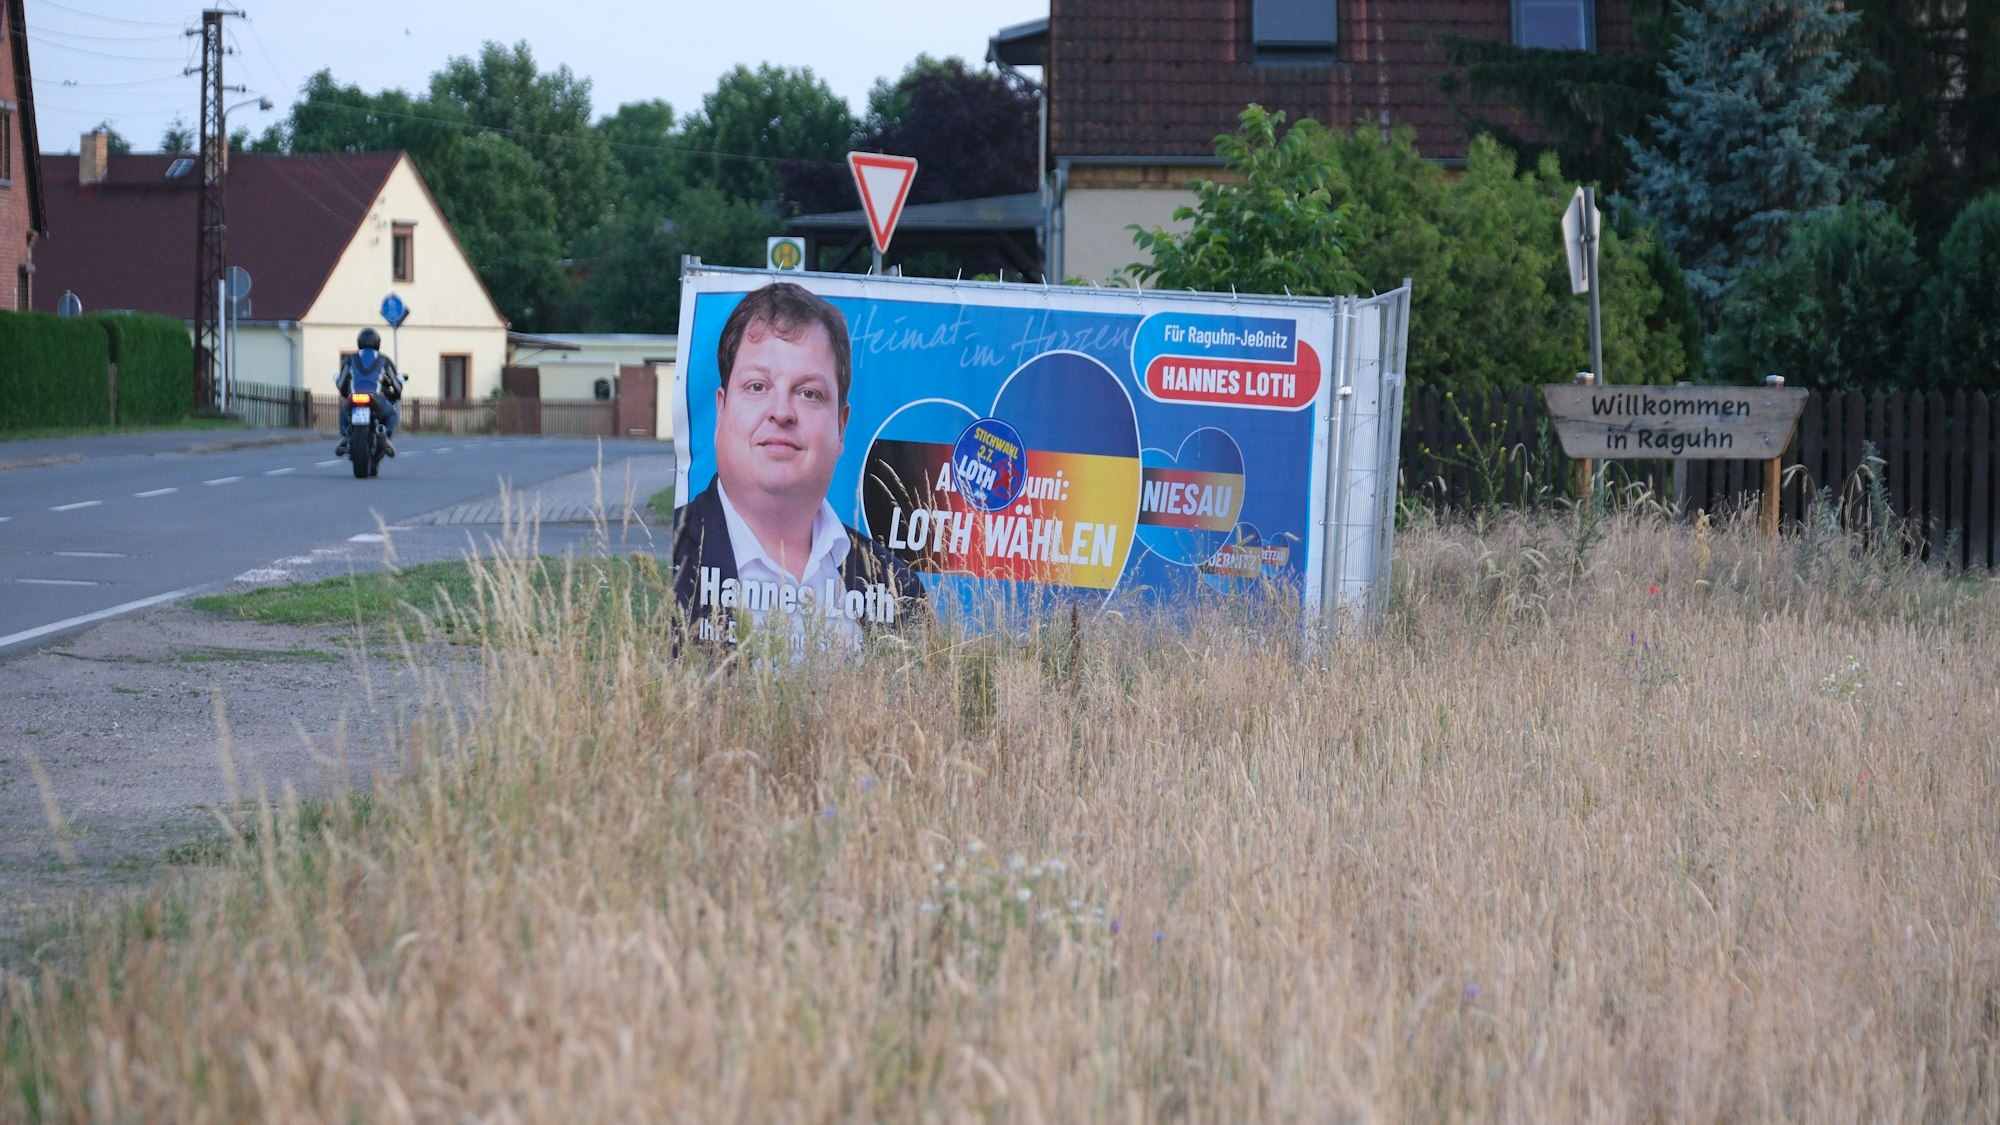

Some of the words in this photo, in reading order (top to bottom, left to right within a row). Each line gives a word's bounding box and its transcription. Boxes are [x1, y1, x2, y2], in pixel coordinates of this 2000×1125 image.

[849, 304, 971, 368] Heimat
[960, 333, 1004, 368] im
[1011, 312, 1133, 367] Herzen
[1164, 324, 1186, 343] Für
[1188, 326, 1288, 349] Raguhn-Jeßnitz
[1162, 365, 1240, 395] HANNES
[1245, 371, 1296, 398] LOTH
[1592, 393, 1751, 416] Willkommen
[974, 427, 1019, 460] STICHWAHL
[1606, 428, 1628, 449] in
[1638, 427, 1733, 455] Raguhn
[958, 454, 997, 491] LOTH
[1142, 480, 1232, 518] NIESAU
[889, 507, 974, 554] LOTH
[984, 504, 1117, 567] WÄHLEN
[700, 566, 814, 613] Hannes
[825, 578, 895, 624] Loth
